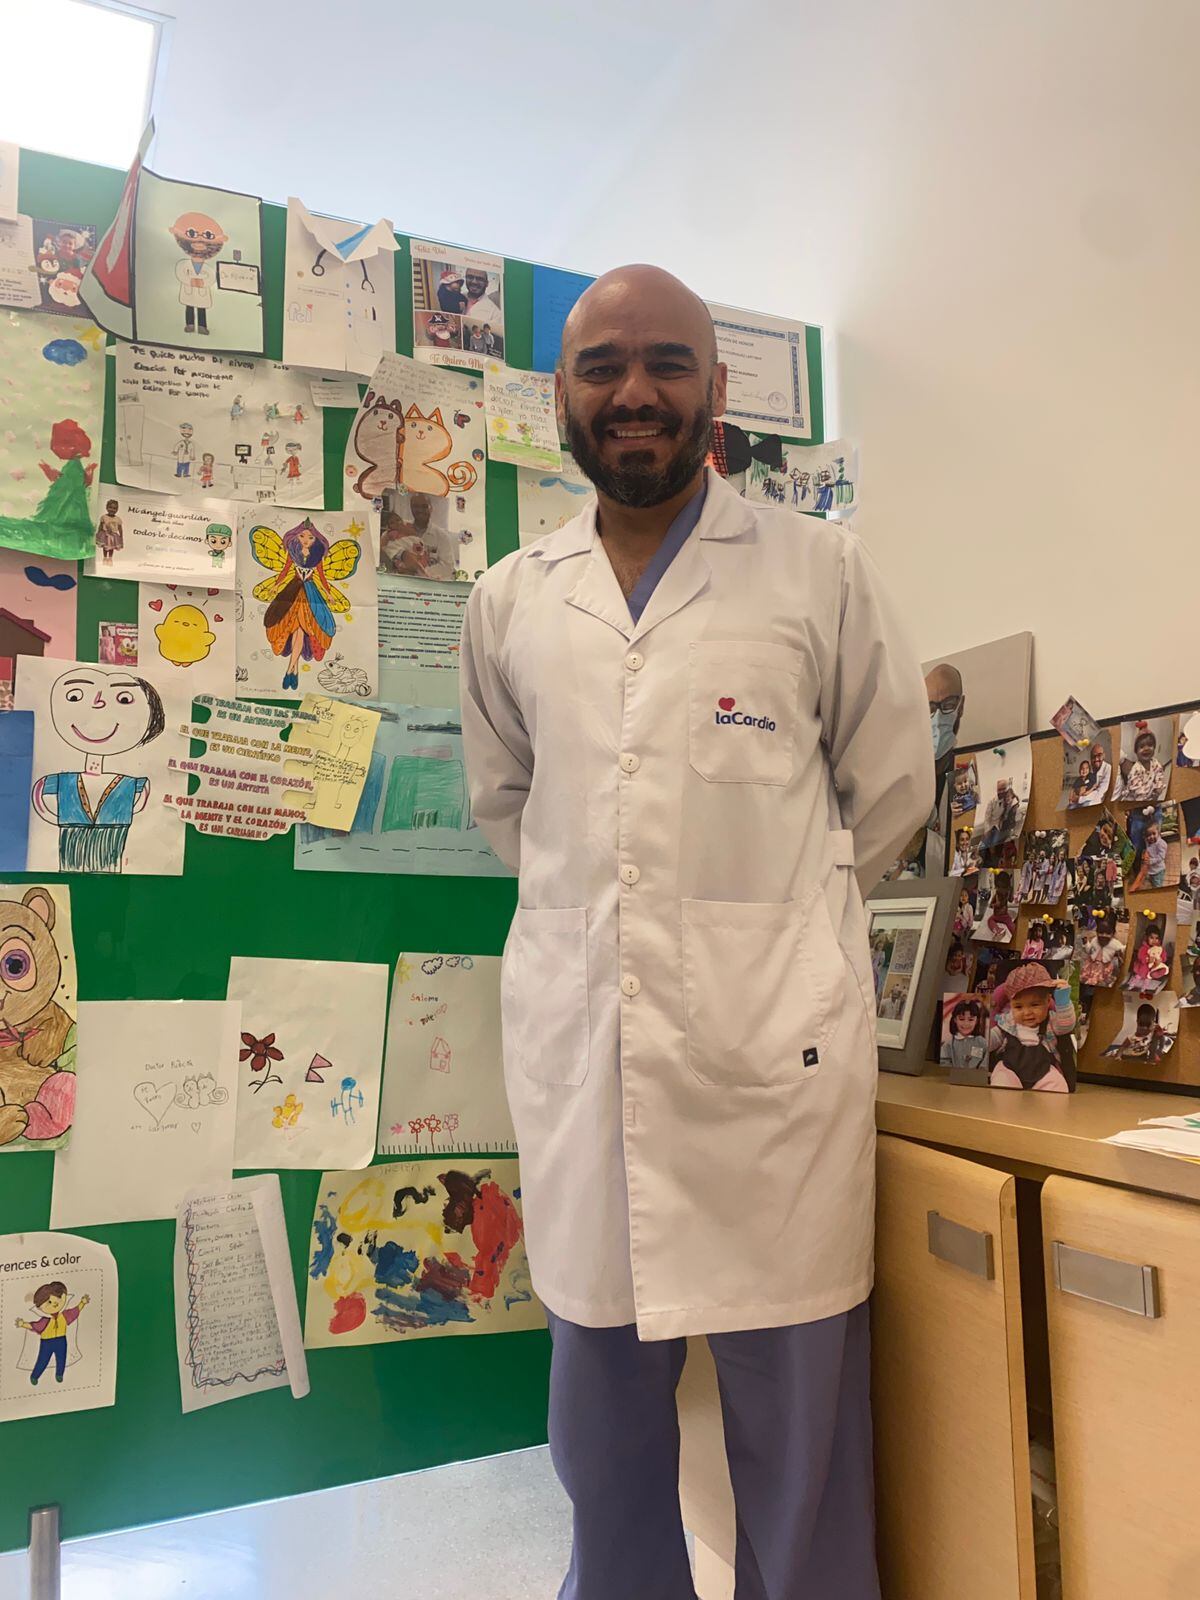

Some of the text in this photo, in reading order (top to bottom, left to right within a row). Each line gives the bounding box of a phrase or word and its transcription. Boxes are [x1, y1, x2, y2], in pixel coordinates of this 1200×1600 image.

[254, 706, 272, 716] CON
[715, 711, 776, 732] laCardio
[180, 724, 189, 734] EL
[192, 727, 209, 738] QUE
[210, 730, 249, 746] TRABAJA
[250, 738, 269, 749] CON
[271, 741, 281, 751] LA
[209, 742, 220, 751] ES
[222, 744, 235, 755] UN
[168, 758, 177, 768] EL
[180, 761, 199, 771] QUE
[200, 764, 237, 779] TRABAJA
[239, 771, 257, 781] CON
[259, 773, 268, 783] EL
[208, 777, 219, 786] ES
[221, 779, 235, 789] UN
[163, 794, 172, 803] EL
[176, 796, 193, 806] QUE
[196, 799, 234, 811] TRABAJA
[237, 804, 254, 813] CON
[256, 806, 272, 815] LAS
[180, 810, 192, 820] LA
[194, 812, 223, 822] MENTE
[226, 815, 232, 823] Y
[233, 816, 243, 824] EL
[199, 823, 208, 832] ES
[211, 824, 224, 833] UN
[40, 1256, 50, 1268] &
[53, 1252, 82, 1266] color
